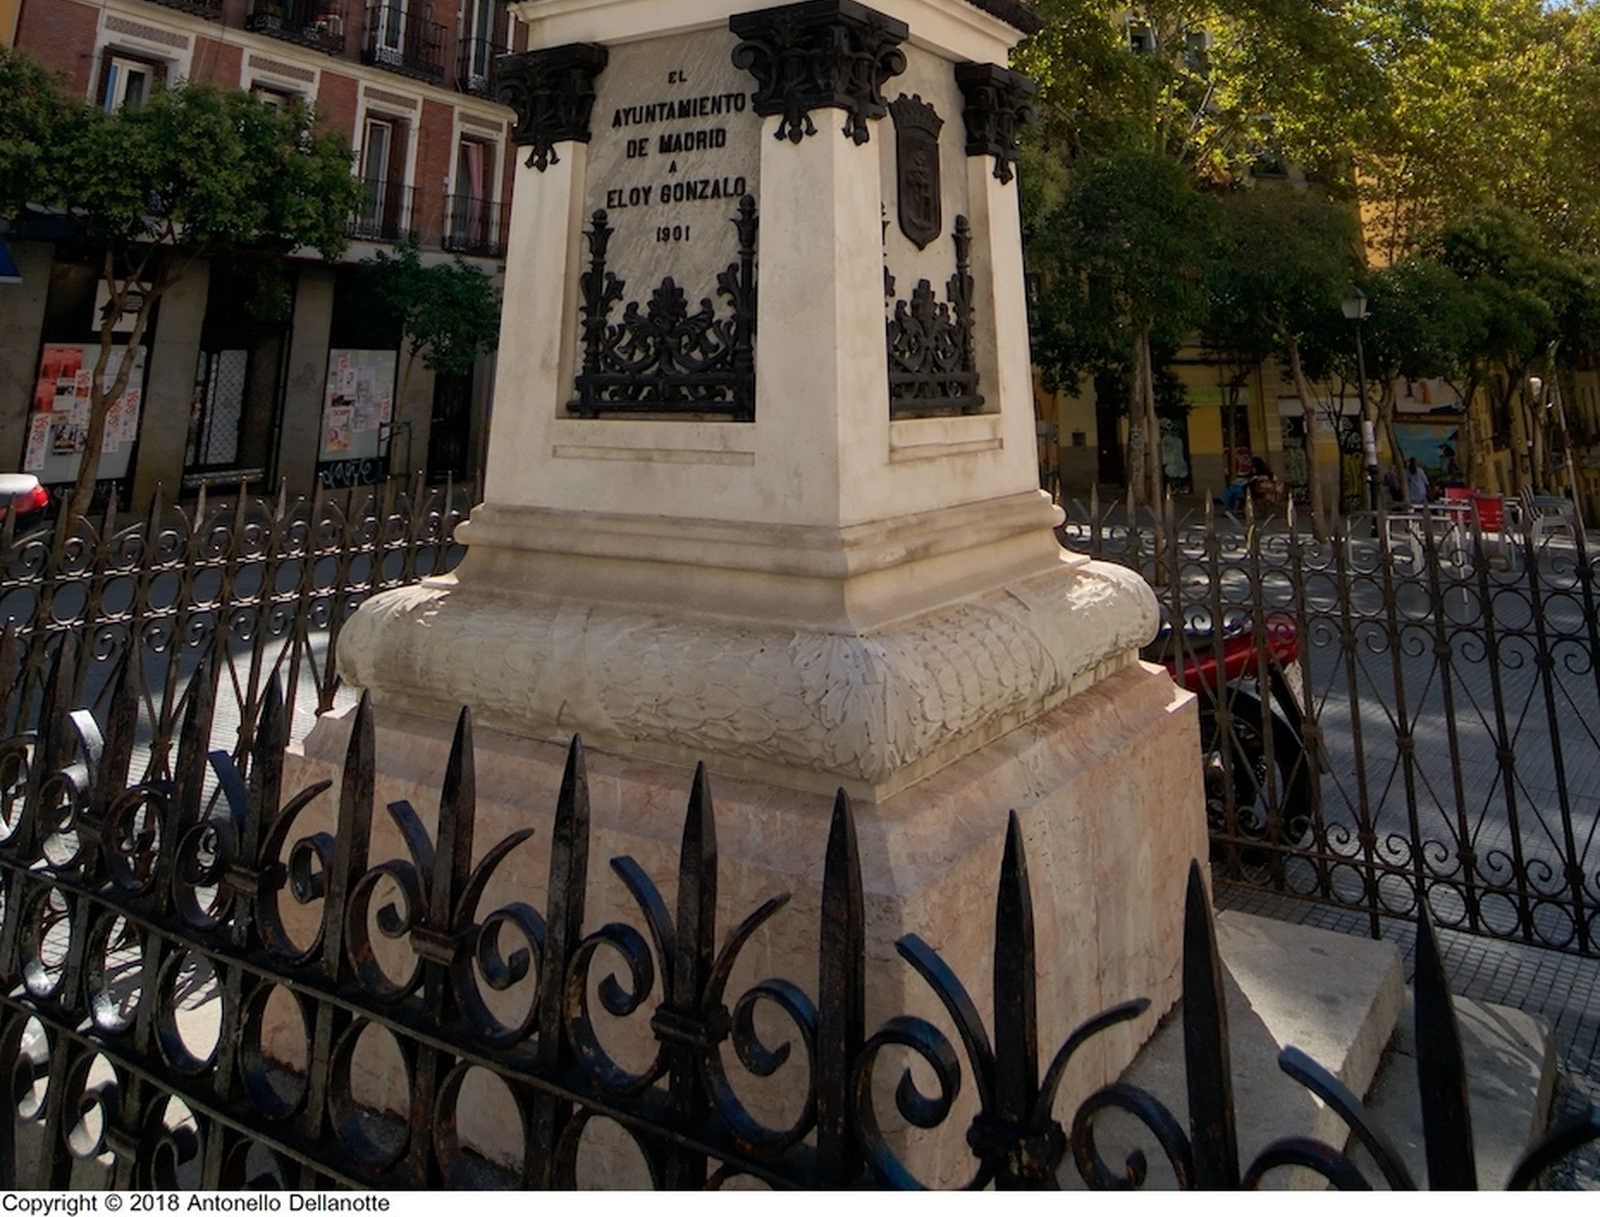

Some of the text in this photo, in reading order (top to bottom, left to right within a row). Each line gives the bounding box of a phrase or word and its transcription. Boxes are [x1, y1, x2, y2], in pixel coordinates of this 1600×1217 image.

[668, 70, 687, 83] EL
[612, 92, 746, 128] AYUNTAMIENTO
[626, 128, 726, 159] DE MADRID
[668, 160, 677, 174] A
[606, 176, 746, 208] ELOY GONZALO
[656, 225, 690, 242] 1901
